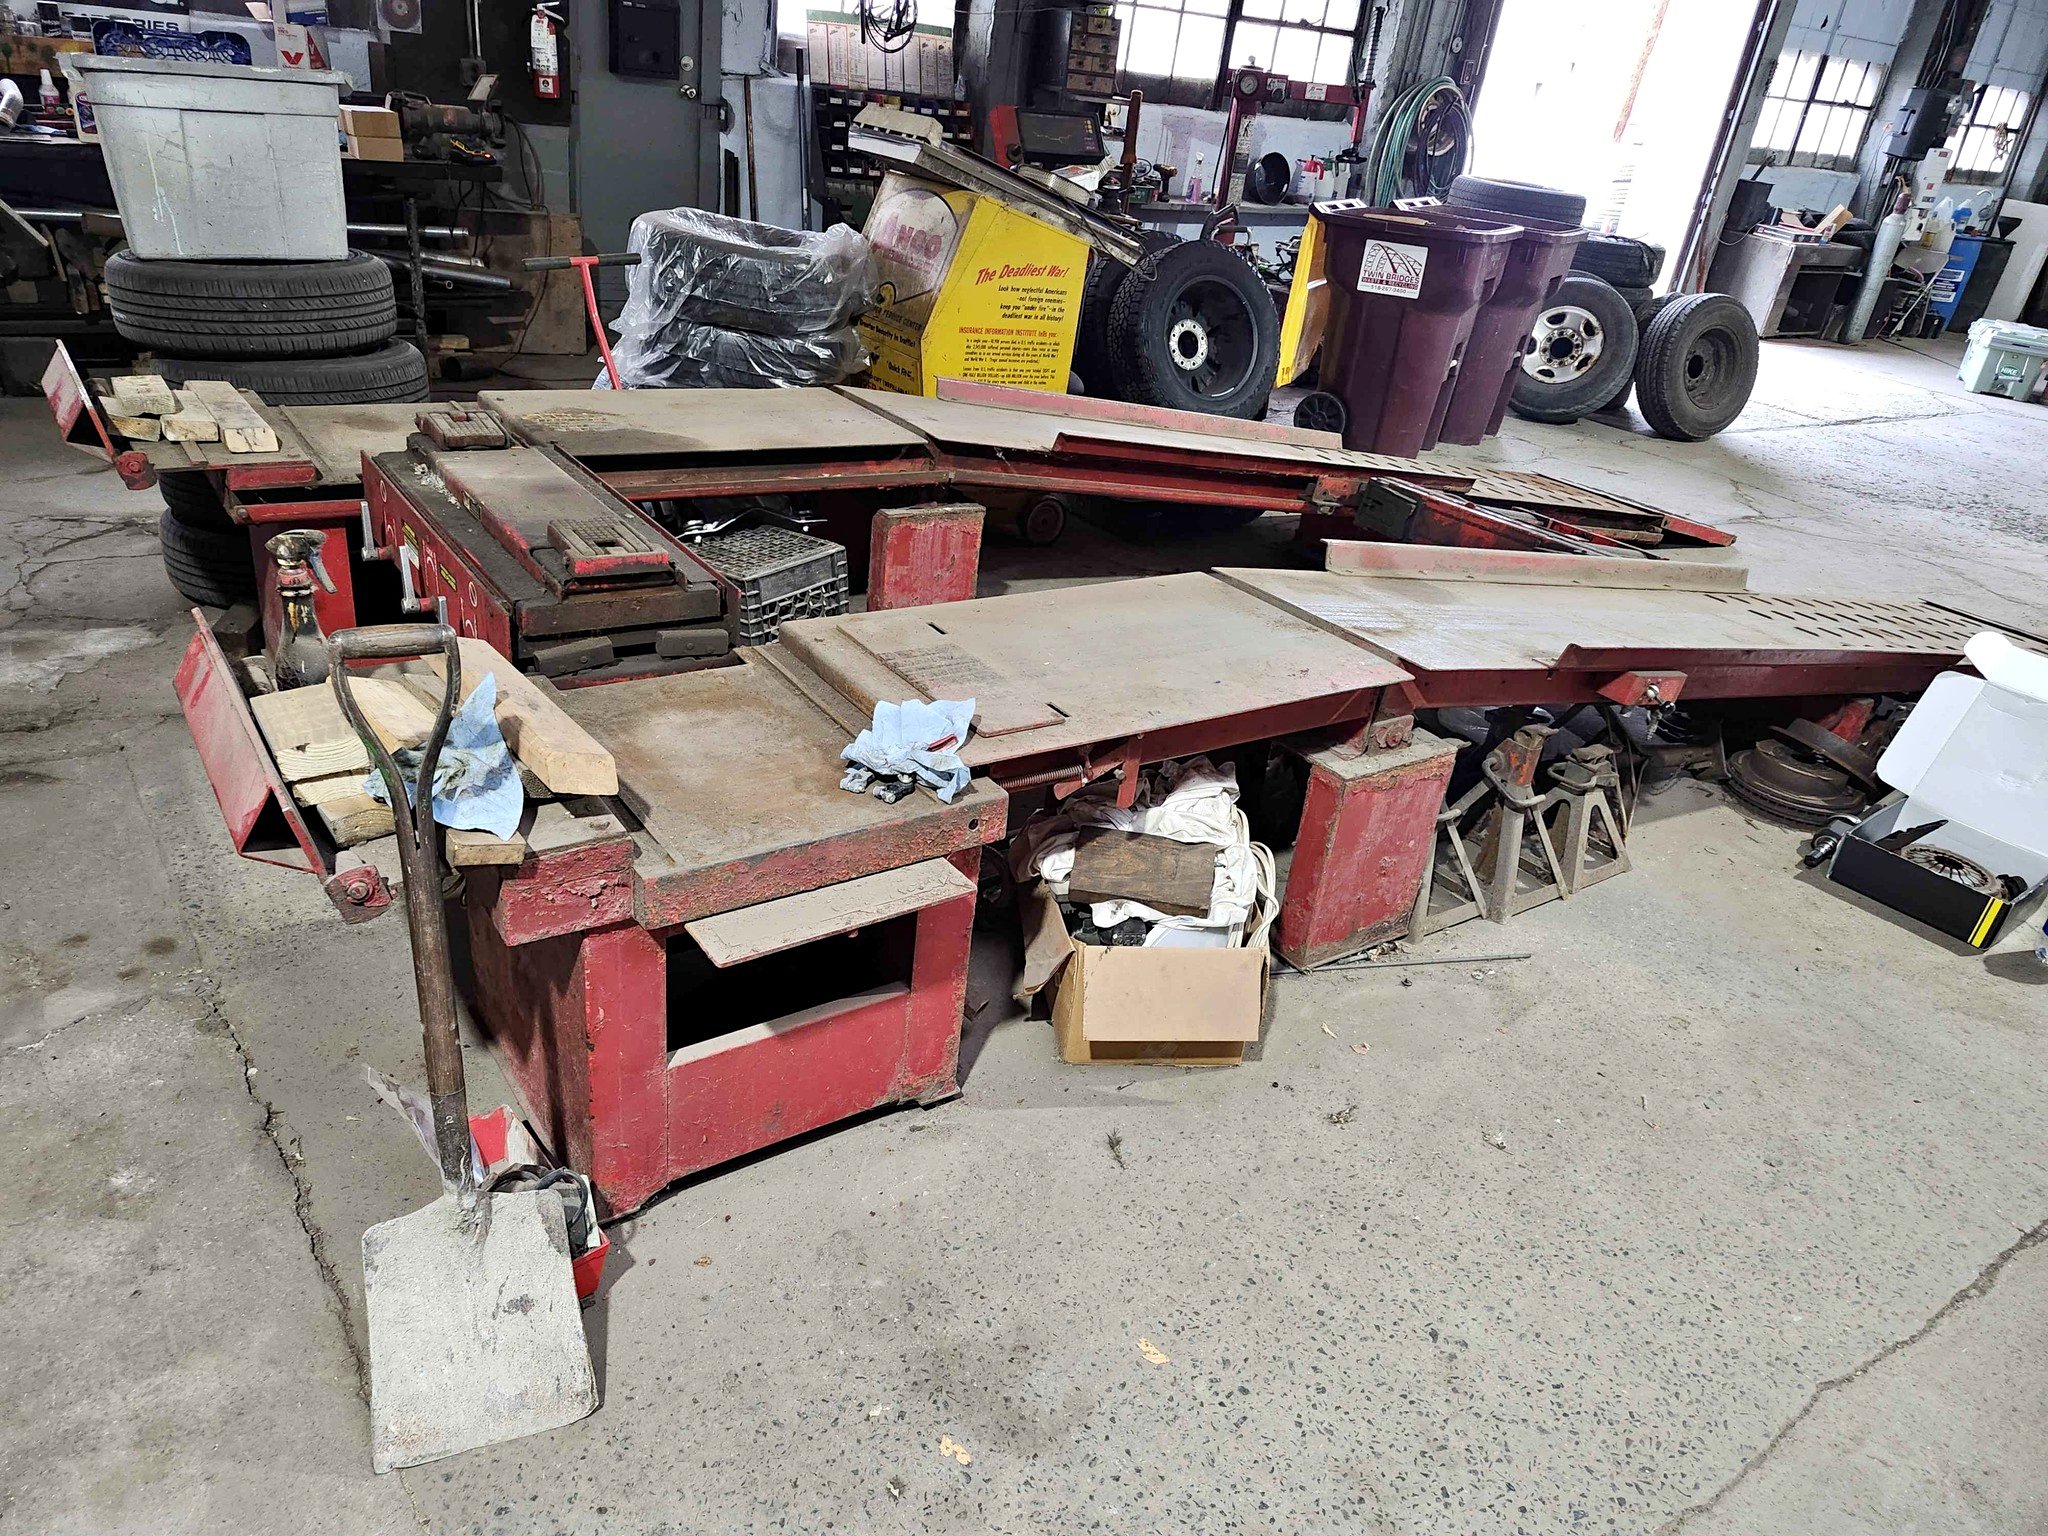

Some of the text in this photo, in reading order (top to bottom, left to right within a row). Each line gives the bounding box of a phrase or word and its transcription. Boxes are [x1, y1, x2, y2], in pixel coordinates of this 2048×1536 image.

[975, 263, 1070, 285] The Deadliest War!
[1363, 269, 1420, 284] TWIN BRIDGES
[1021, 286, 1044, 294] neglectful
[1045, 287, 1067, 295] Americans
[1028, 295, 1044, 304] foreign
[1046, 315, 1064, 323] history!
[958, 326, 983, 335] INSURANCE
[984, 327, 1014, 336] INFORMATION
[1015, 329, 1037, 337] INSTITUTE
